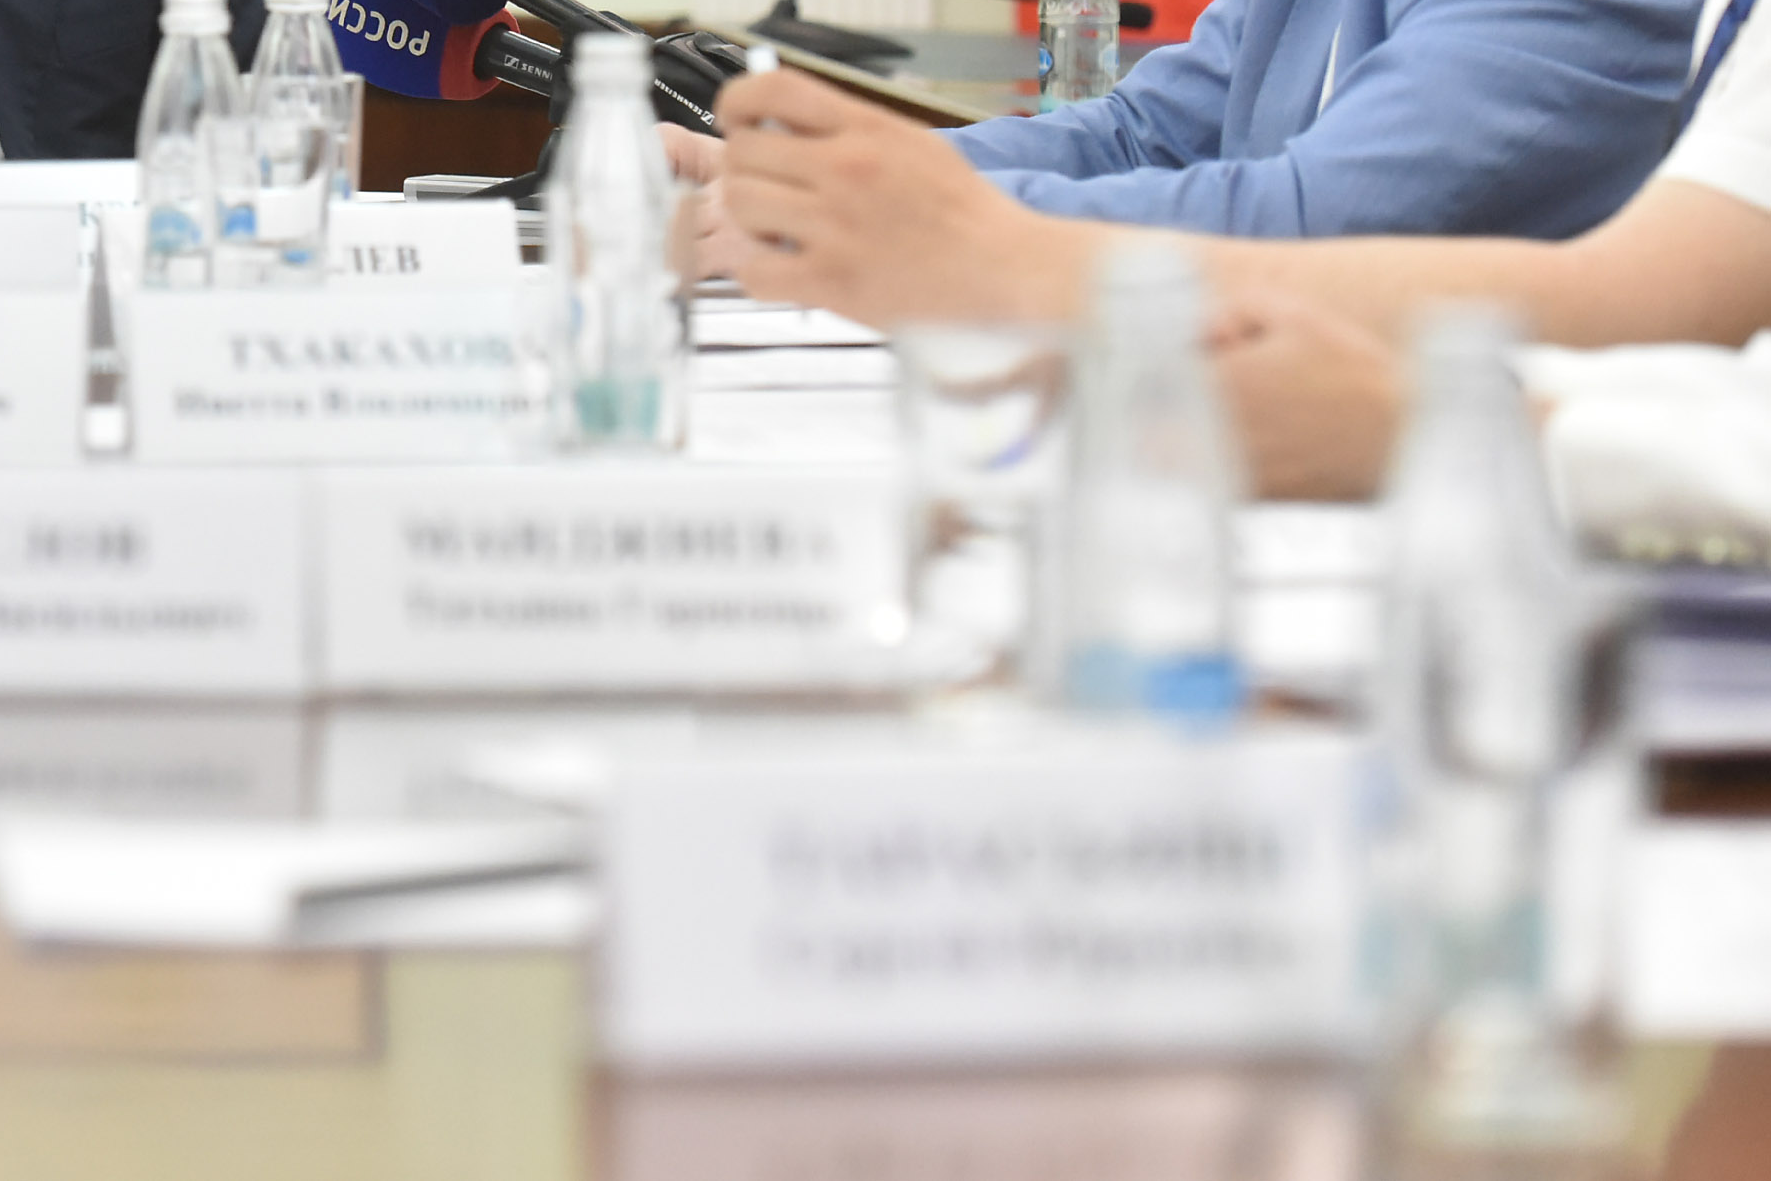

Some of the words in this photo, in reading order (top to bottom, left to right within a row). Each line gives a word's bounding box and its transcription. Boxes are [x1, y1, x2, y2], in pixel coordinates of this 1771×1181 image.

[521, 63, 553, 81] SENN
[654, 79, 704, 116] SENNHEISER
[326, 243, 422, 275] ЛЕВ
